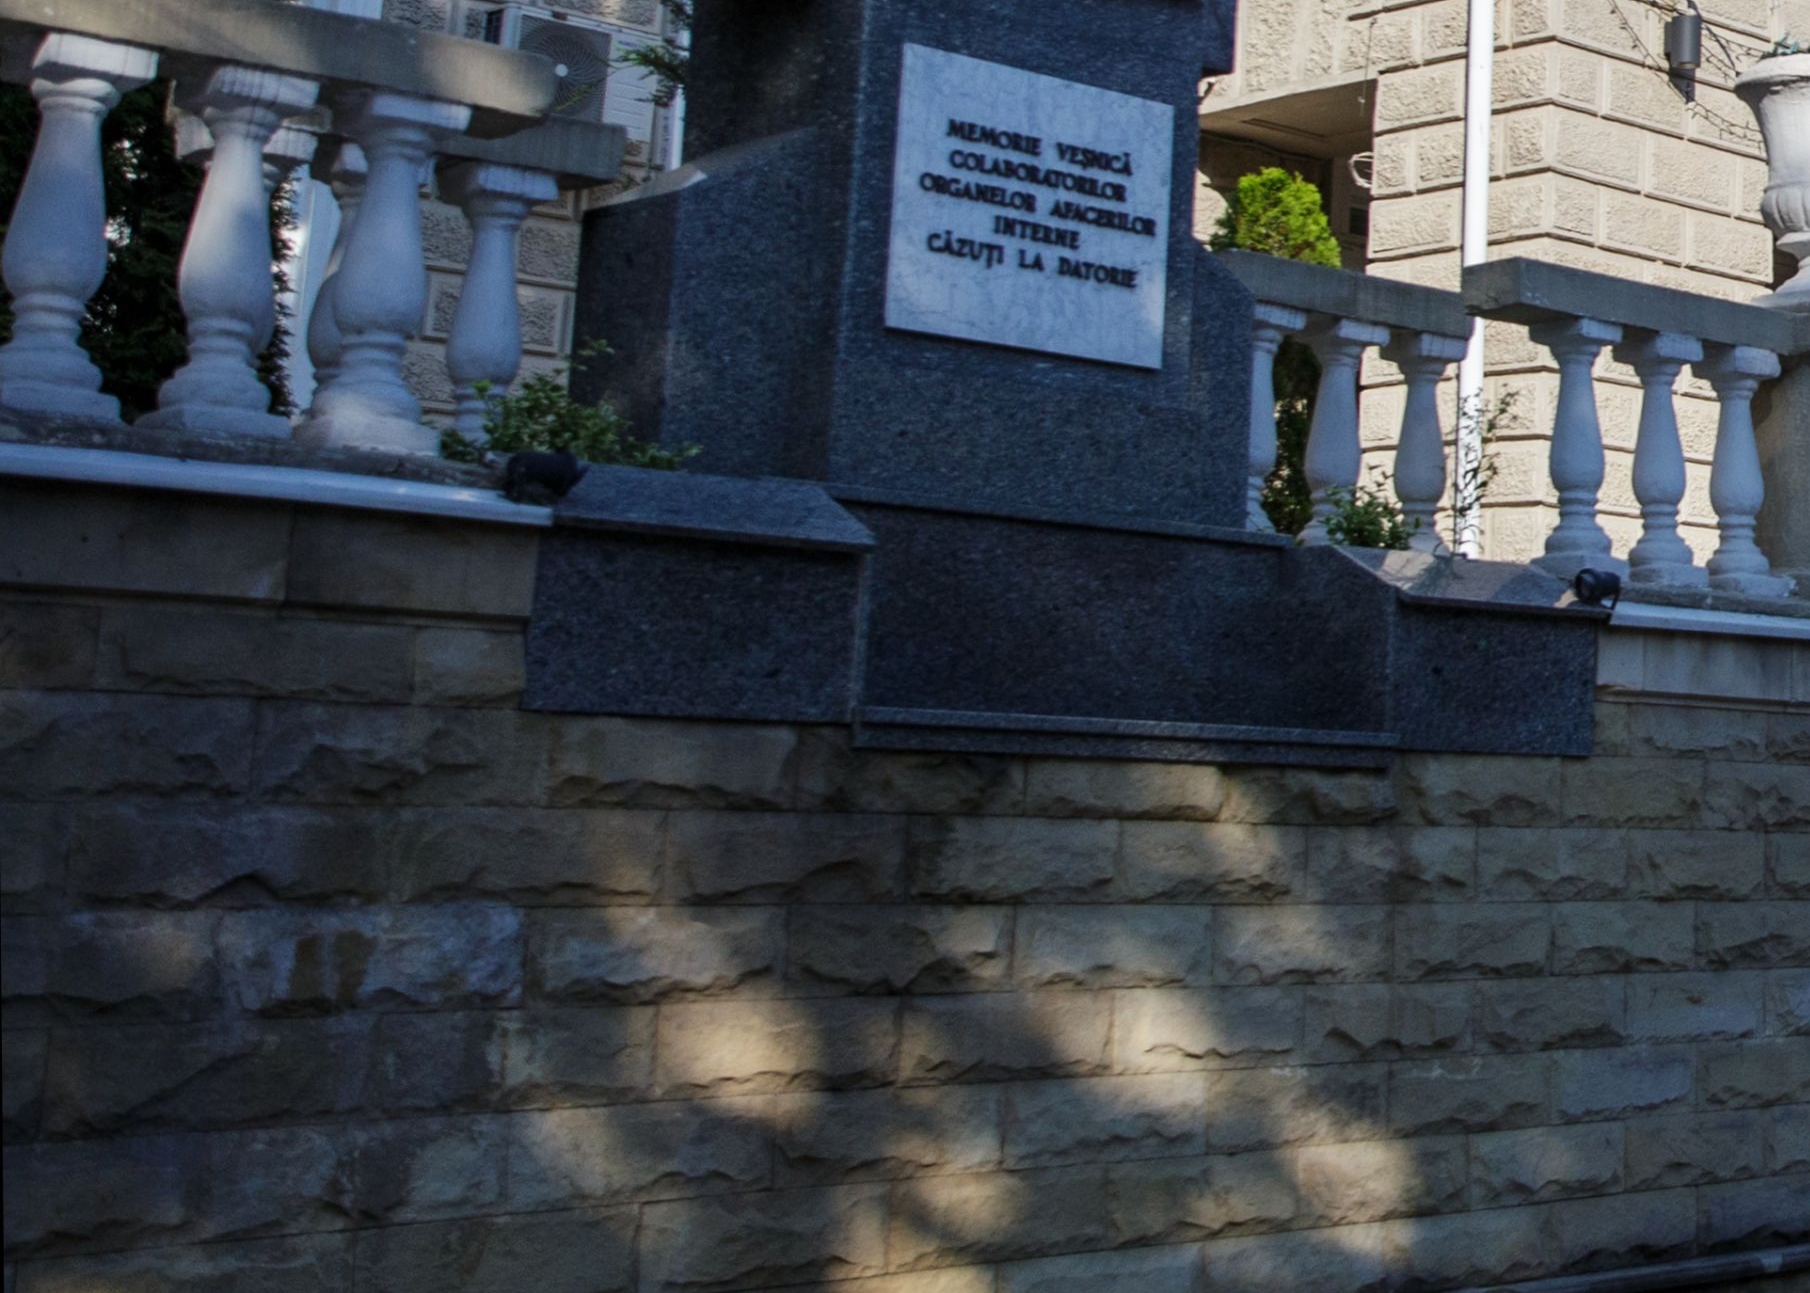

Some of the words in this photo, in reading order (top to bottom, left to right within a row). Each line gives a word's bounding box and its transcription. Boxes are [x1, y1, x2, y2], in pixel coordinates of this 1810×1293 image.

[946, 118, 1042, 157] MEMORIE
[949, 149, 1127, 203] COLABORATORILOR
[919, 171, 1037, 213] ORGANELOR
[1049, 199, 1157, 238] AFACERILOR
[993, 215, 1081, 250] INTERNE
[1017, 248, 1045, 272] LA
[1057, 255, 1139, 288] DATORIE
